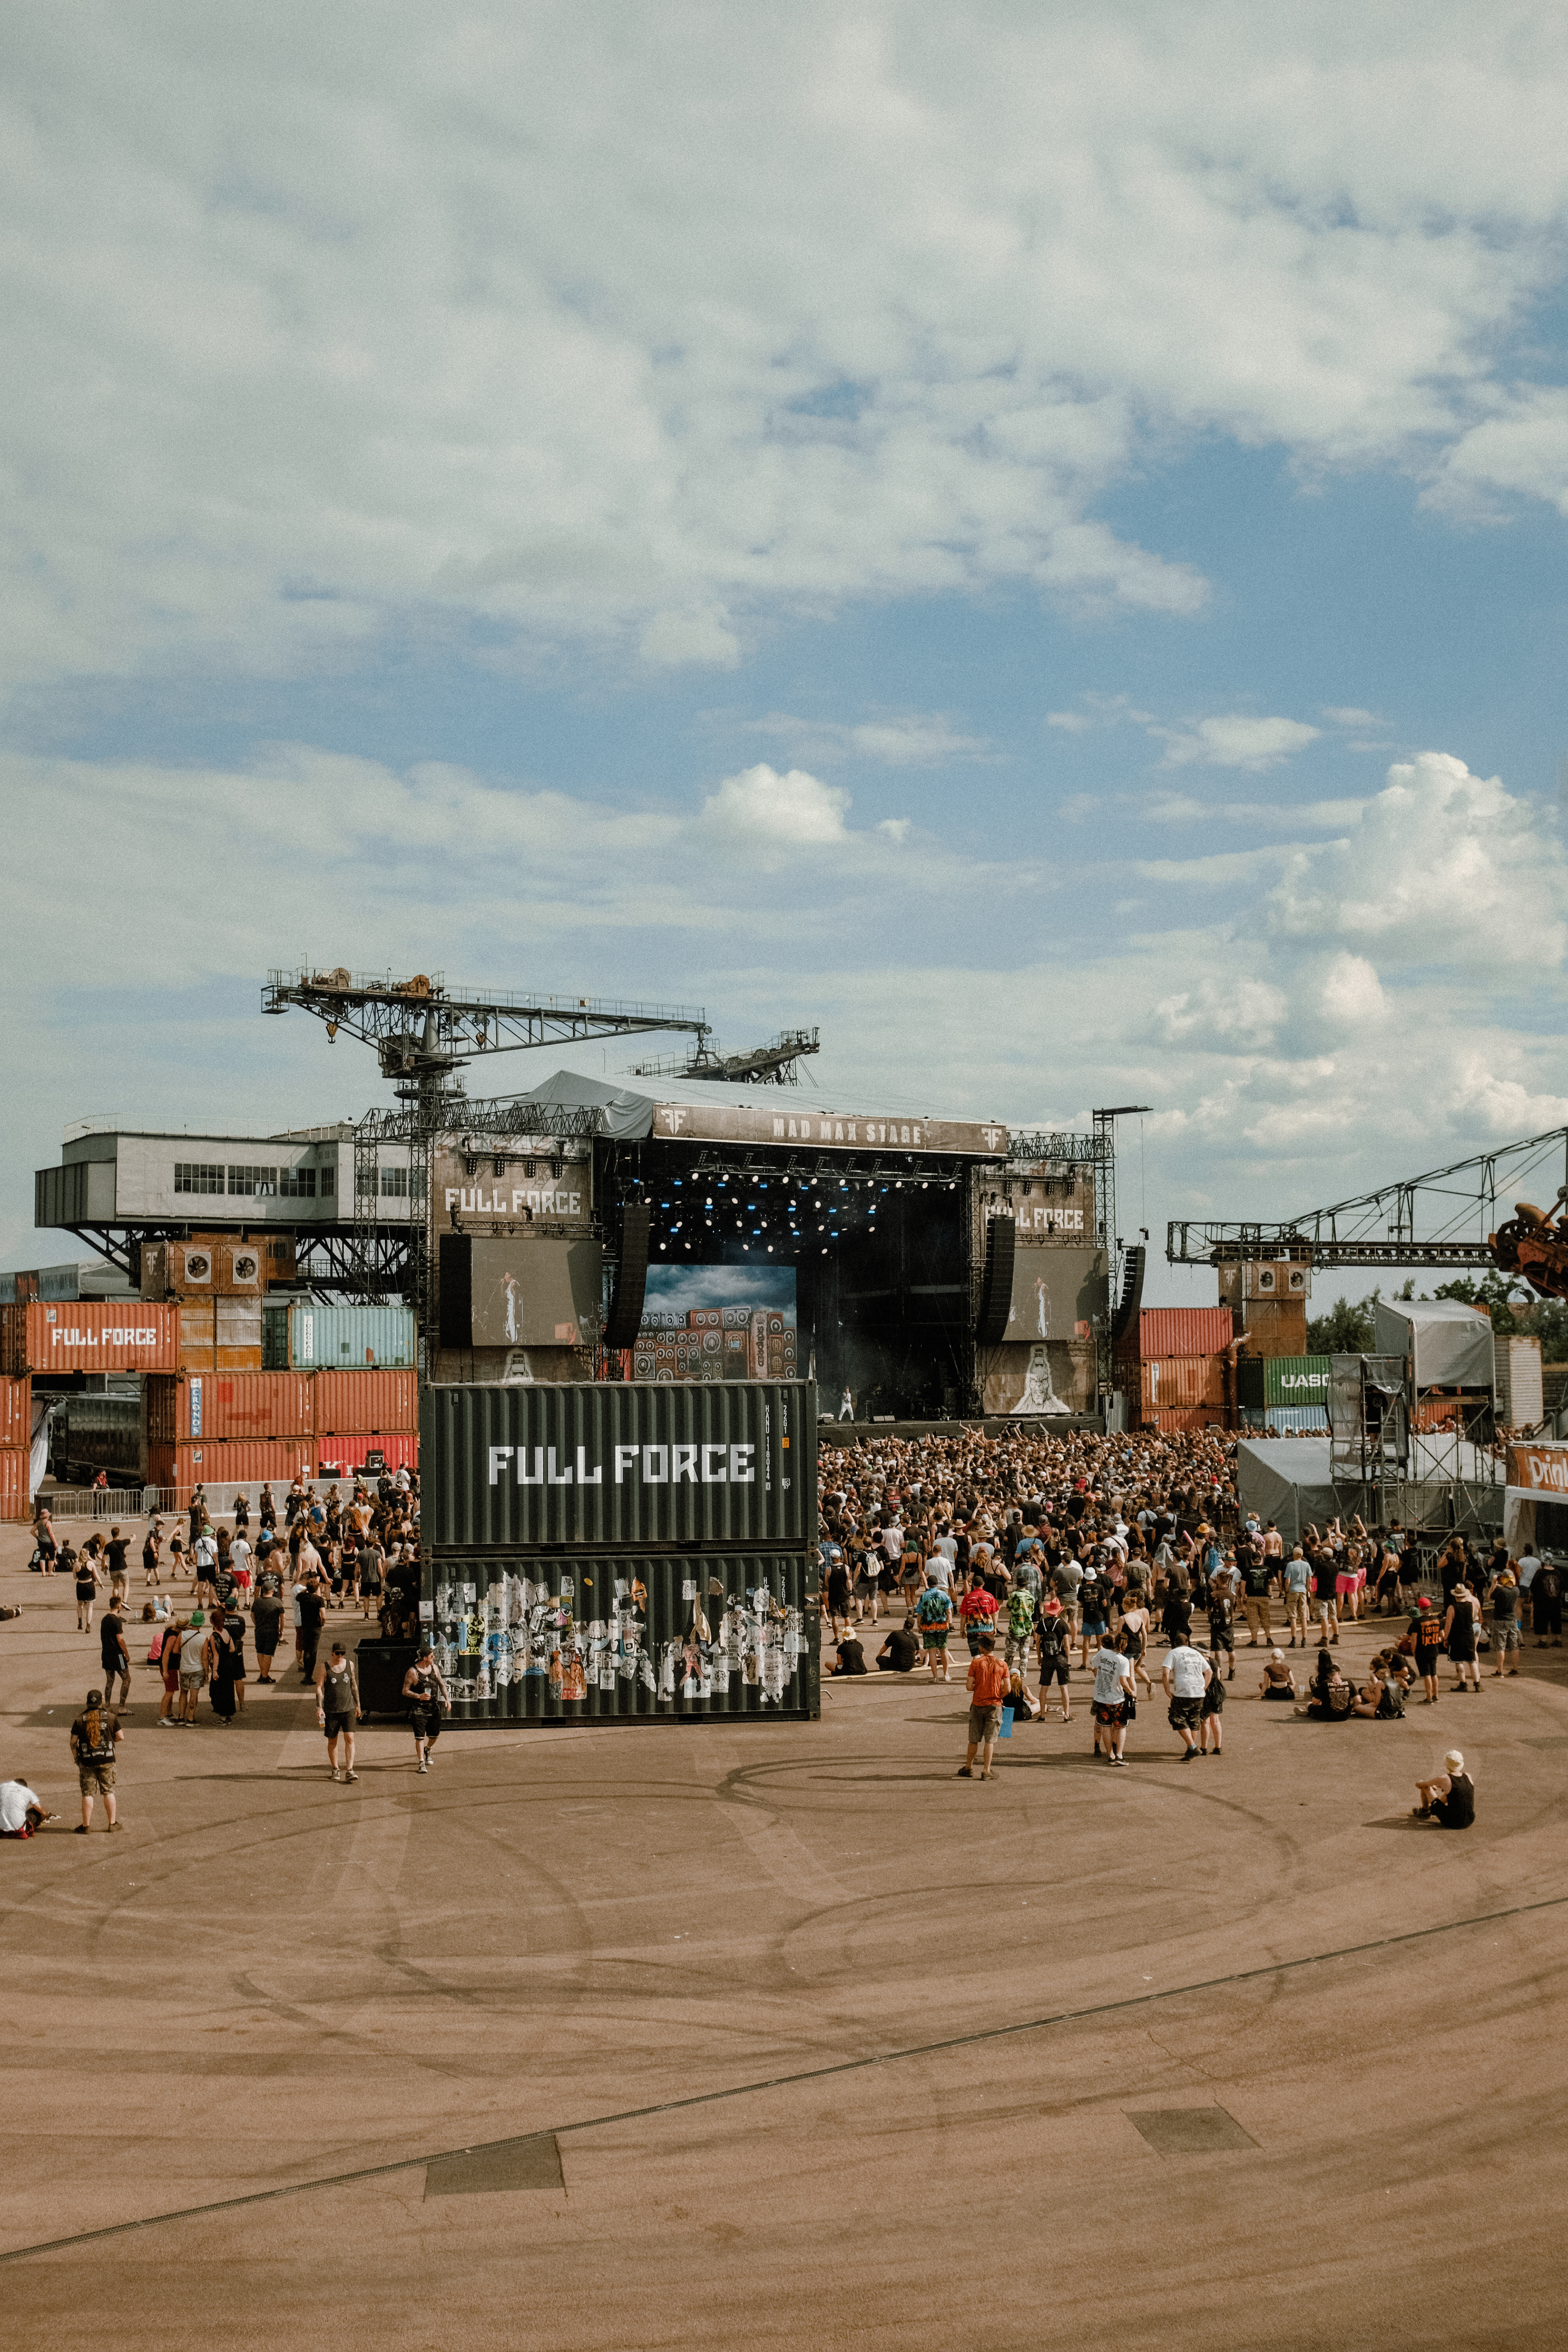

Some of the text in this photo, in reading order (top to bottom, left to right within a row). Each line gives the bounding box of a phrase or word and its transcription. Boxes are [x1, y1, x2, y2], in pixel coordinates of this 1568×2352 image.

[773, 1118, 921, 1143] MAD MAX STAGE
[445, 1188, 581, 1214] FULL FORCE
[1034, 1207, 1084, 1229] FORCE
[53, 1328, 156, 1346] FULL FORCE
[489, 1444, 755, 1485] FULL FORCE
